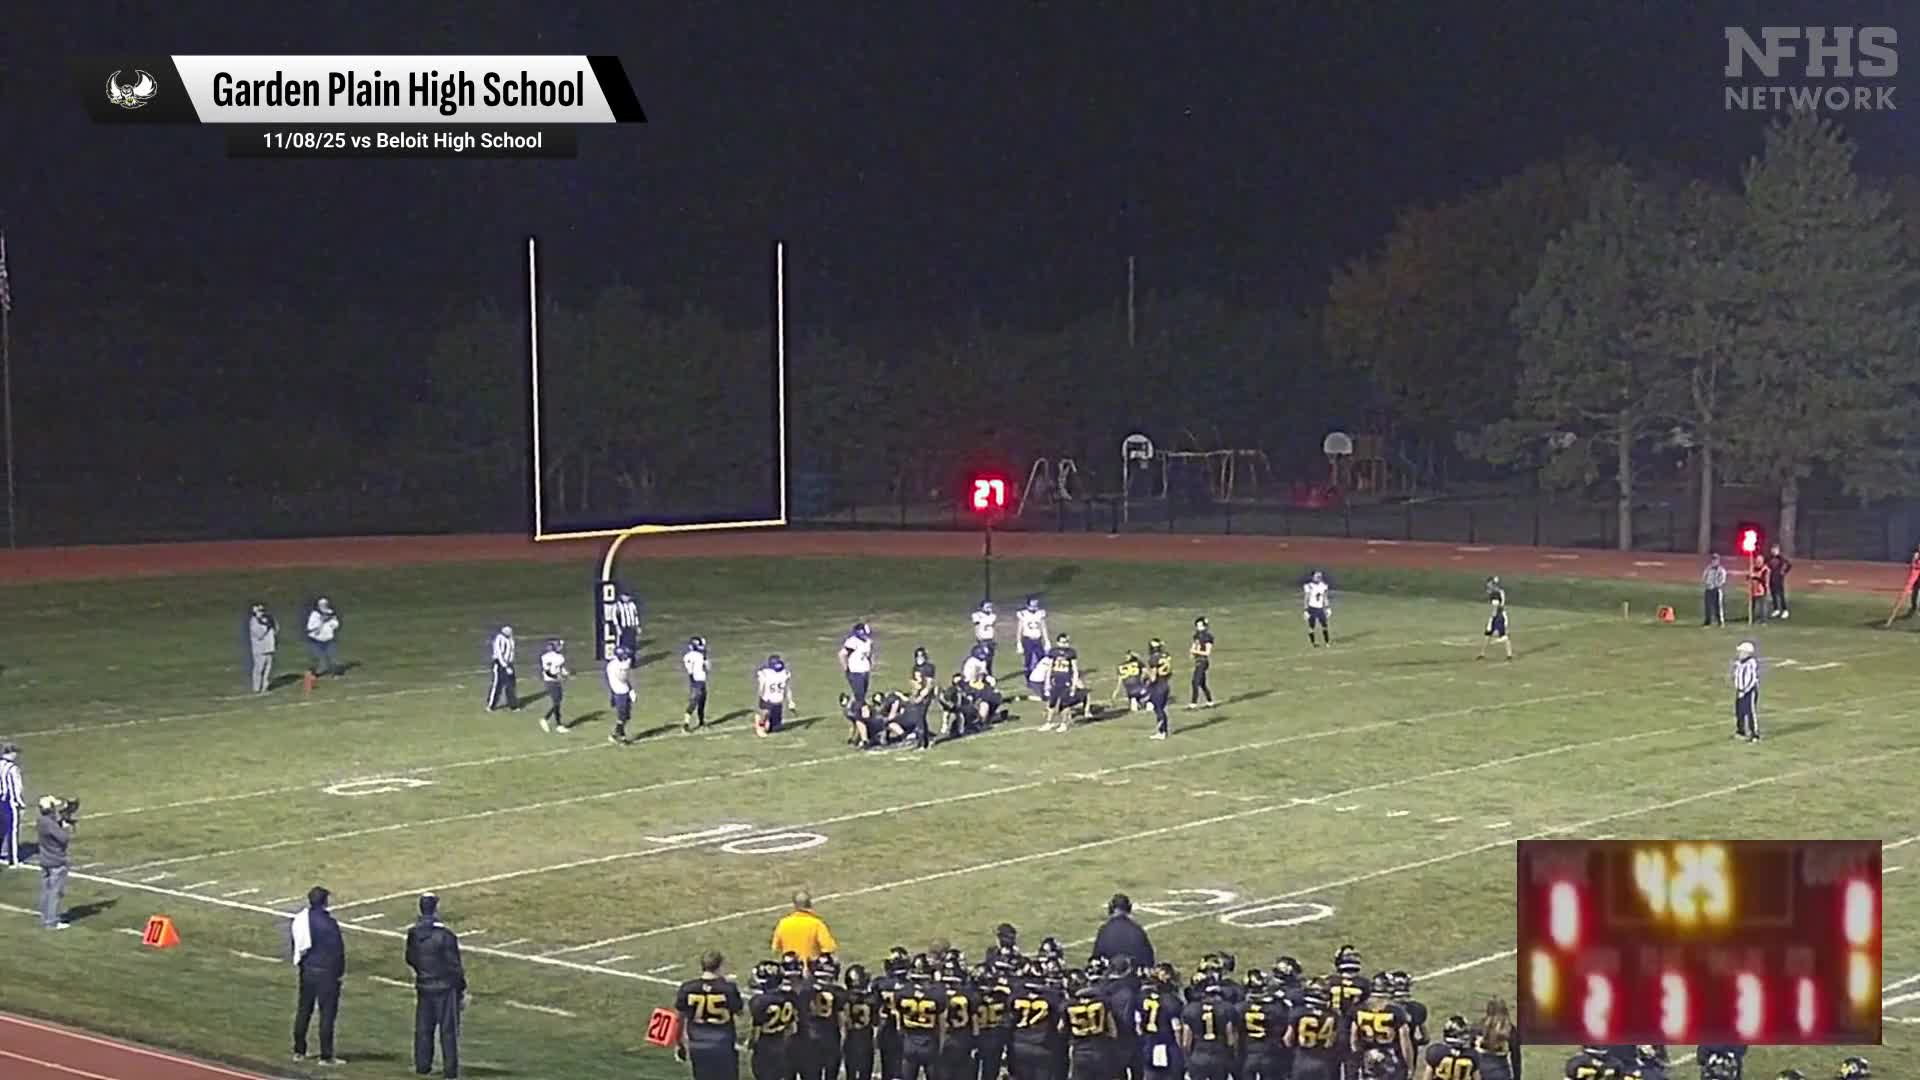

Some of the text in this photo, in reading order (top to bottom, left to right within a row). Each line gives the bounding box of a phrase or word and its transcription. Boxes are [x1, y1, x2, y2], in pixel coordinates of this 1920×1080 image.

[974, 479, 1004, 507] 27
[643, 823, 828, 854] 10
[1103, 888, 1334, 928] 20
[147, 920, 163, 943] 10
[687, 994, 731, 1024] 75
[648, 1012, 672, 1041] 20
[1202, 1011, 1216, 1041] 1
[1245, 1012, 1266, 1039] 5
[1298, 1016, 1336, 1048] 64
[1357, 1010, 1395, 1044] 55
